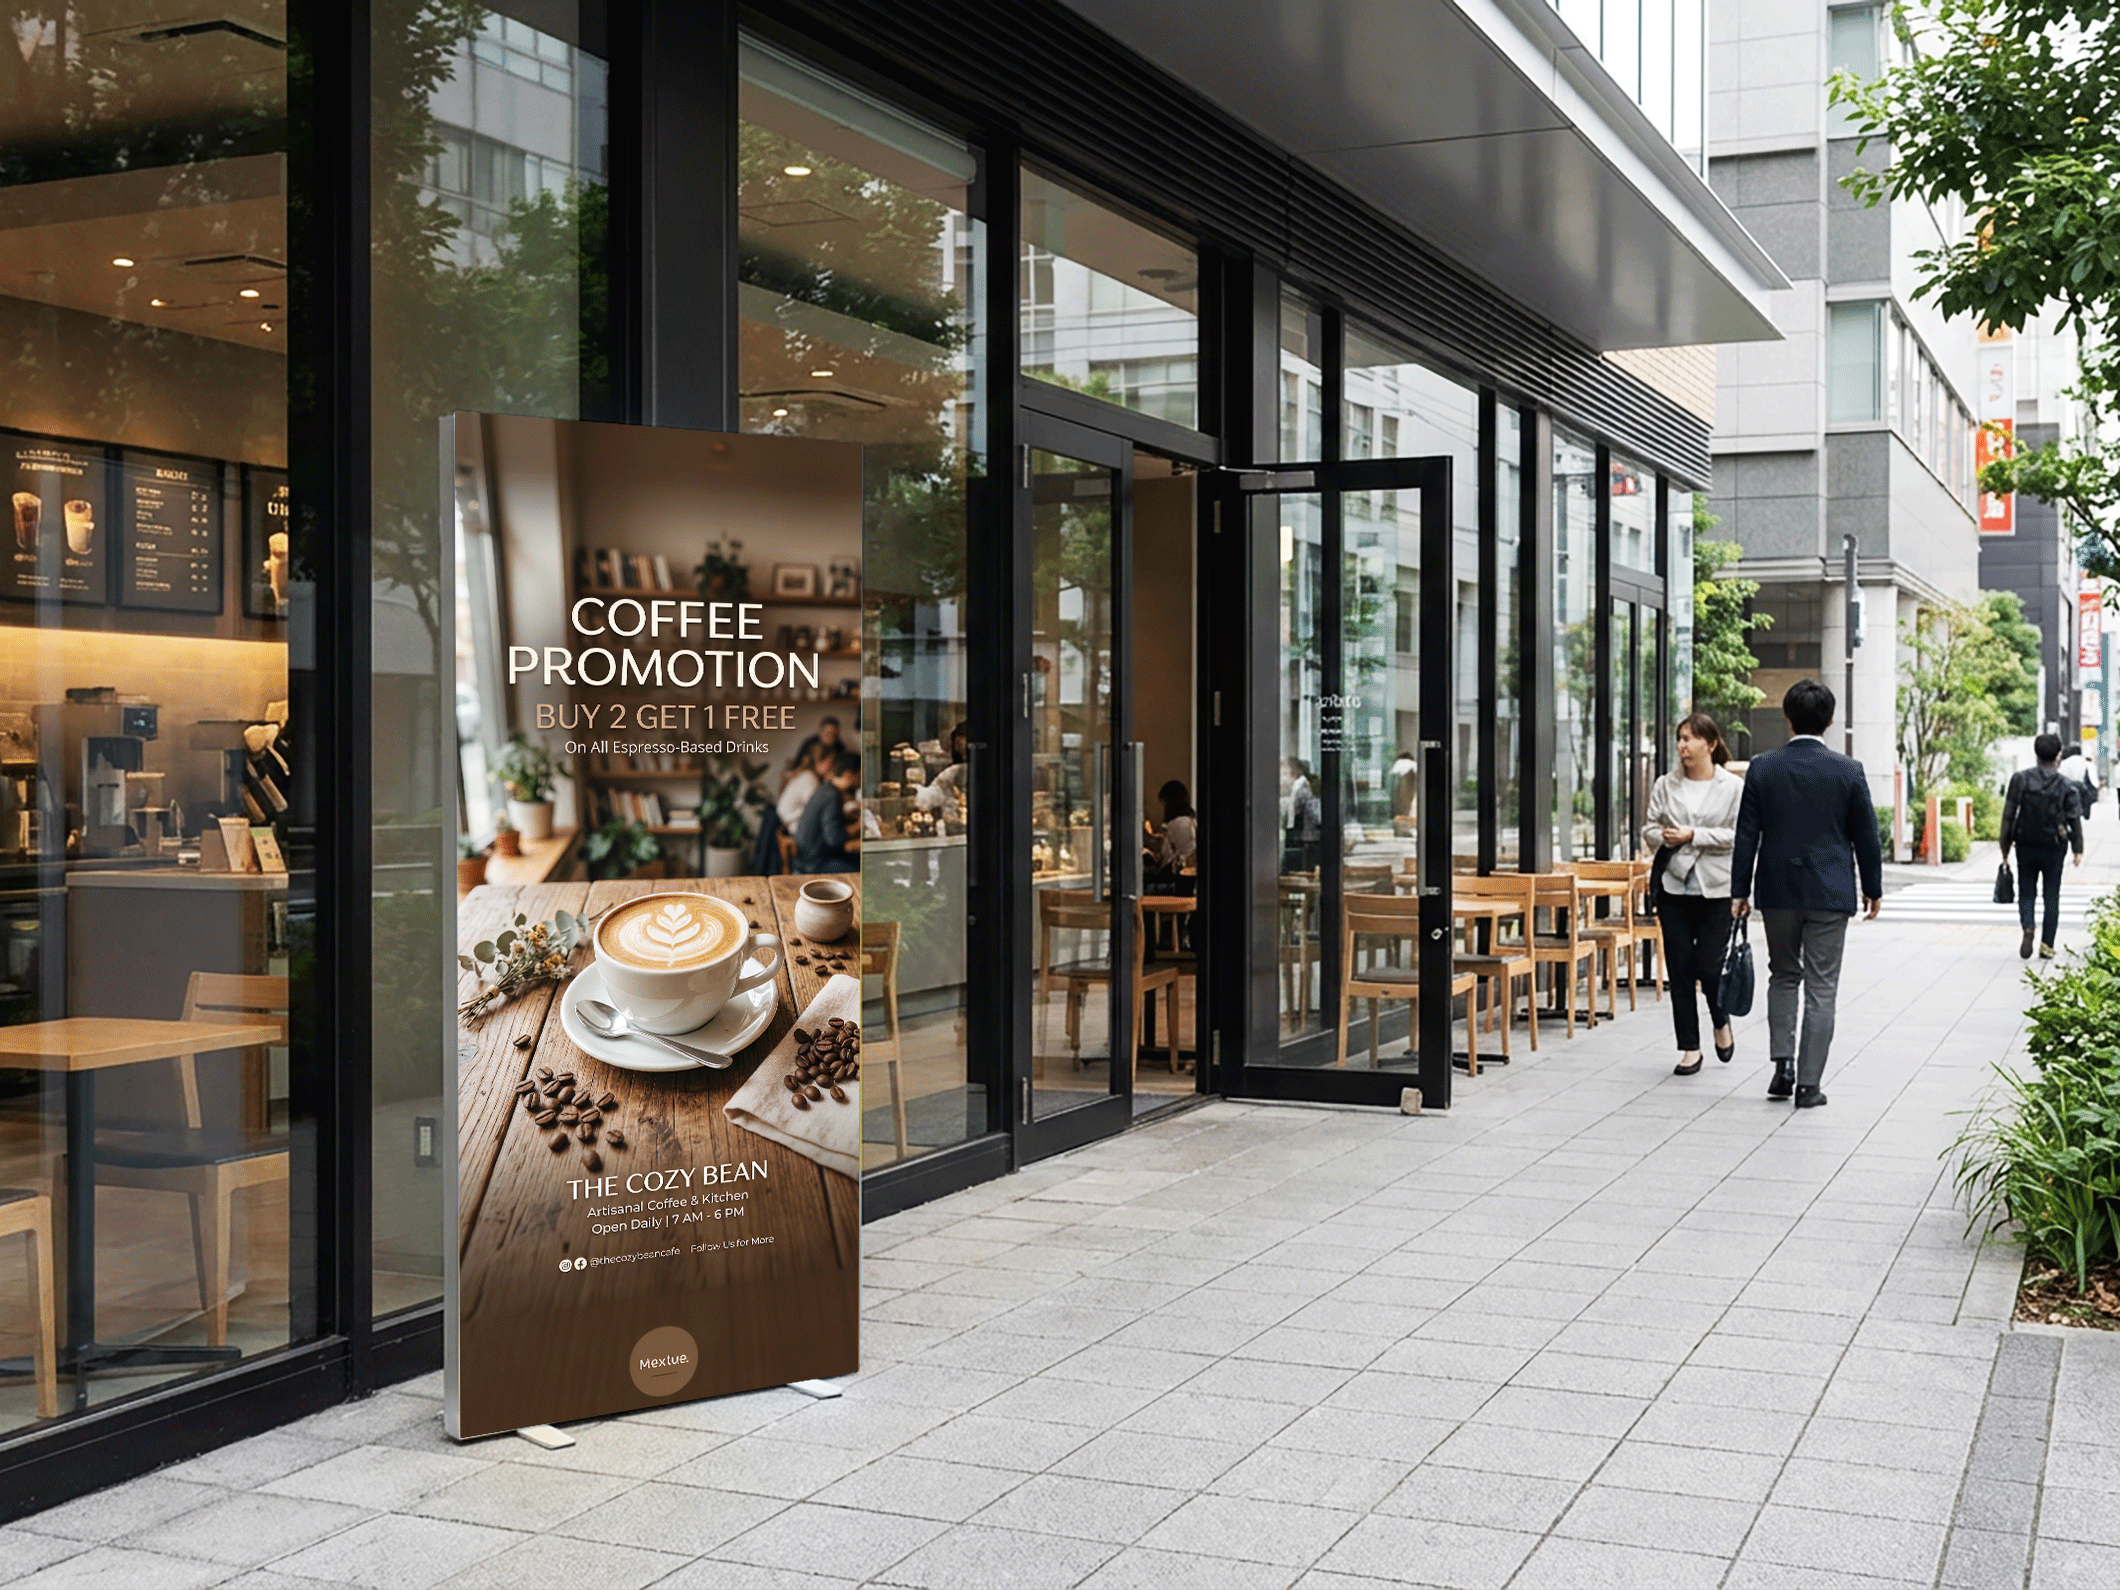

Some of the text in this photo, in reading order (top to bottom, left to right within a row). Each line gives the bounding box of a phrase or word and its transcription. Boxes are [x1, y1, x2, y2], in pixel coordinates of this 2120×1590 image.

[571, 597, 763, 640] COFFEE
[508, 646, 819, 688] PROMOTION
[536, 703, 796, 730] BUY 2 GET 1 FREE
[564, 740, 769, 757] On All Espresso-Based Drinks
[566, 1160, 768, 1200] THE COZY BEAN
[587, 1190, 749, 1219] Artisanal Coffee & Kitchen
[591, 1221, 628, 1236] Open
[630, 1215, 663, 1230] Daily
[672, 1214, 680, 1225] 7
[682, 1211, 703, 1224] AM
[714, 1209, 722, 1220] 6
[725, 1206, 745, 1218] PM
[589, 1246, 681, 1268] @thecozybeancafe
[690, 1236, 775, 1253] Follow Us for More
